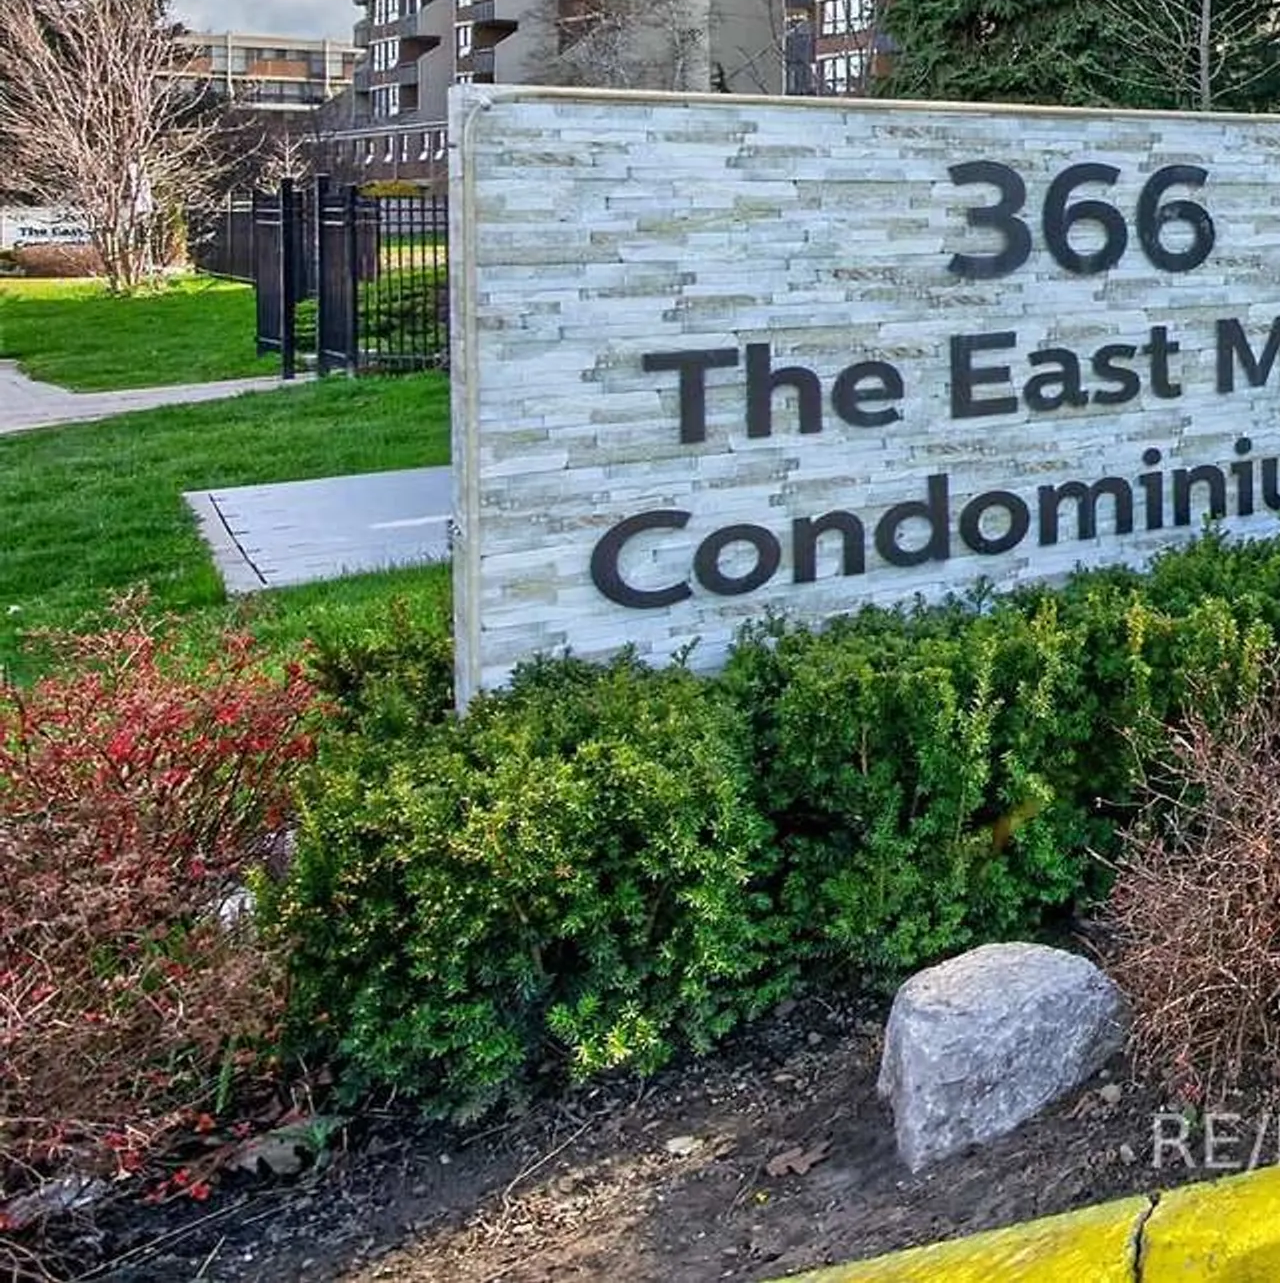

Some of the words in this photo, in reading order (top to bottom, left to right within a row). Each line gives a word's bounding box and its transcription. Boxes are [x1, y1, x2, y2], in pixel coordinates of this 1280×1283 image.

[947, 160, 1216, 279] 366
[643, 344, 903, 444] The
[949, 327, 1181, 418] East
